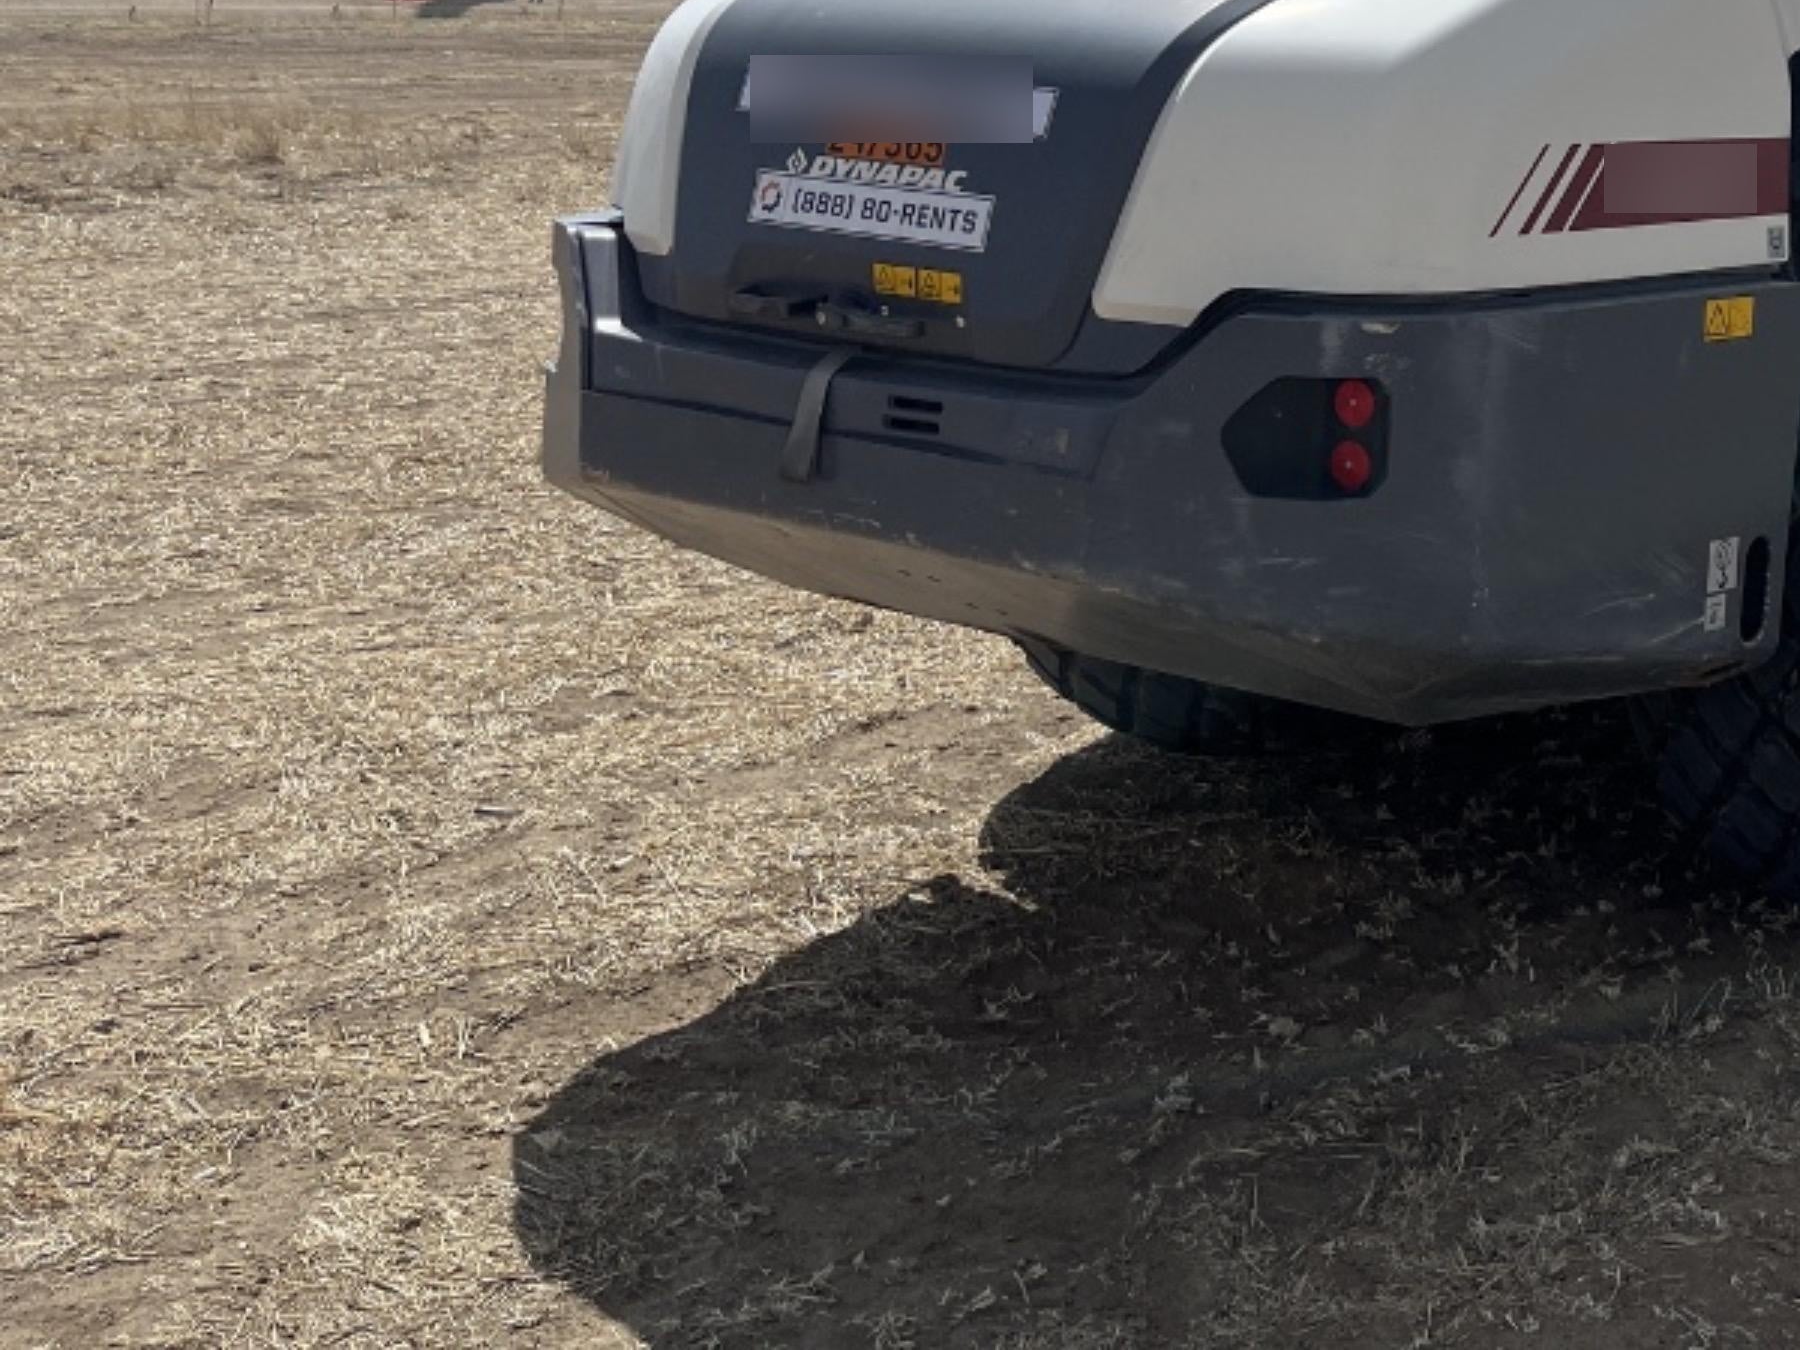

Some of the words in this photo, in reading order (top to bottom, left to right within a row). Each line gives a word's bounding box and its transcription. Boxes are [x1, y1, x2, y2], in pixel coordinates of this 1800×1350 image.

[809, 154, 968, 194] DYNAPAC
[792, 188, 855, 219] (888)
[860, 197, 978, 234] 80-RENTS
